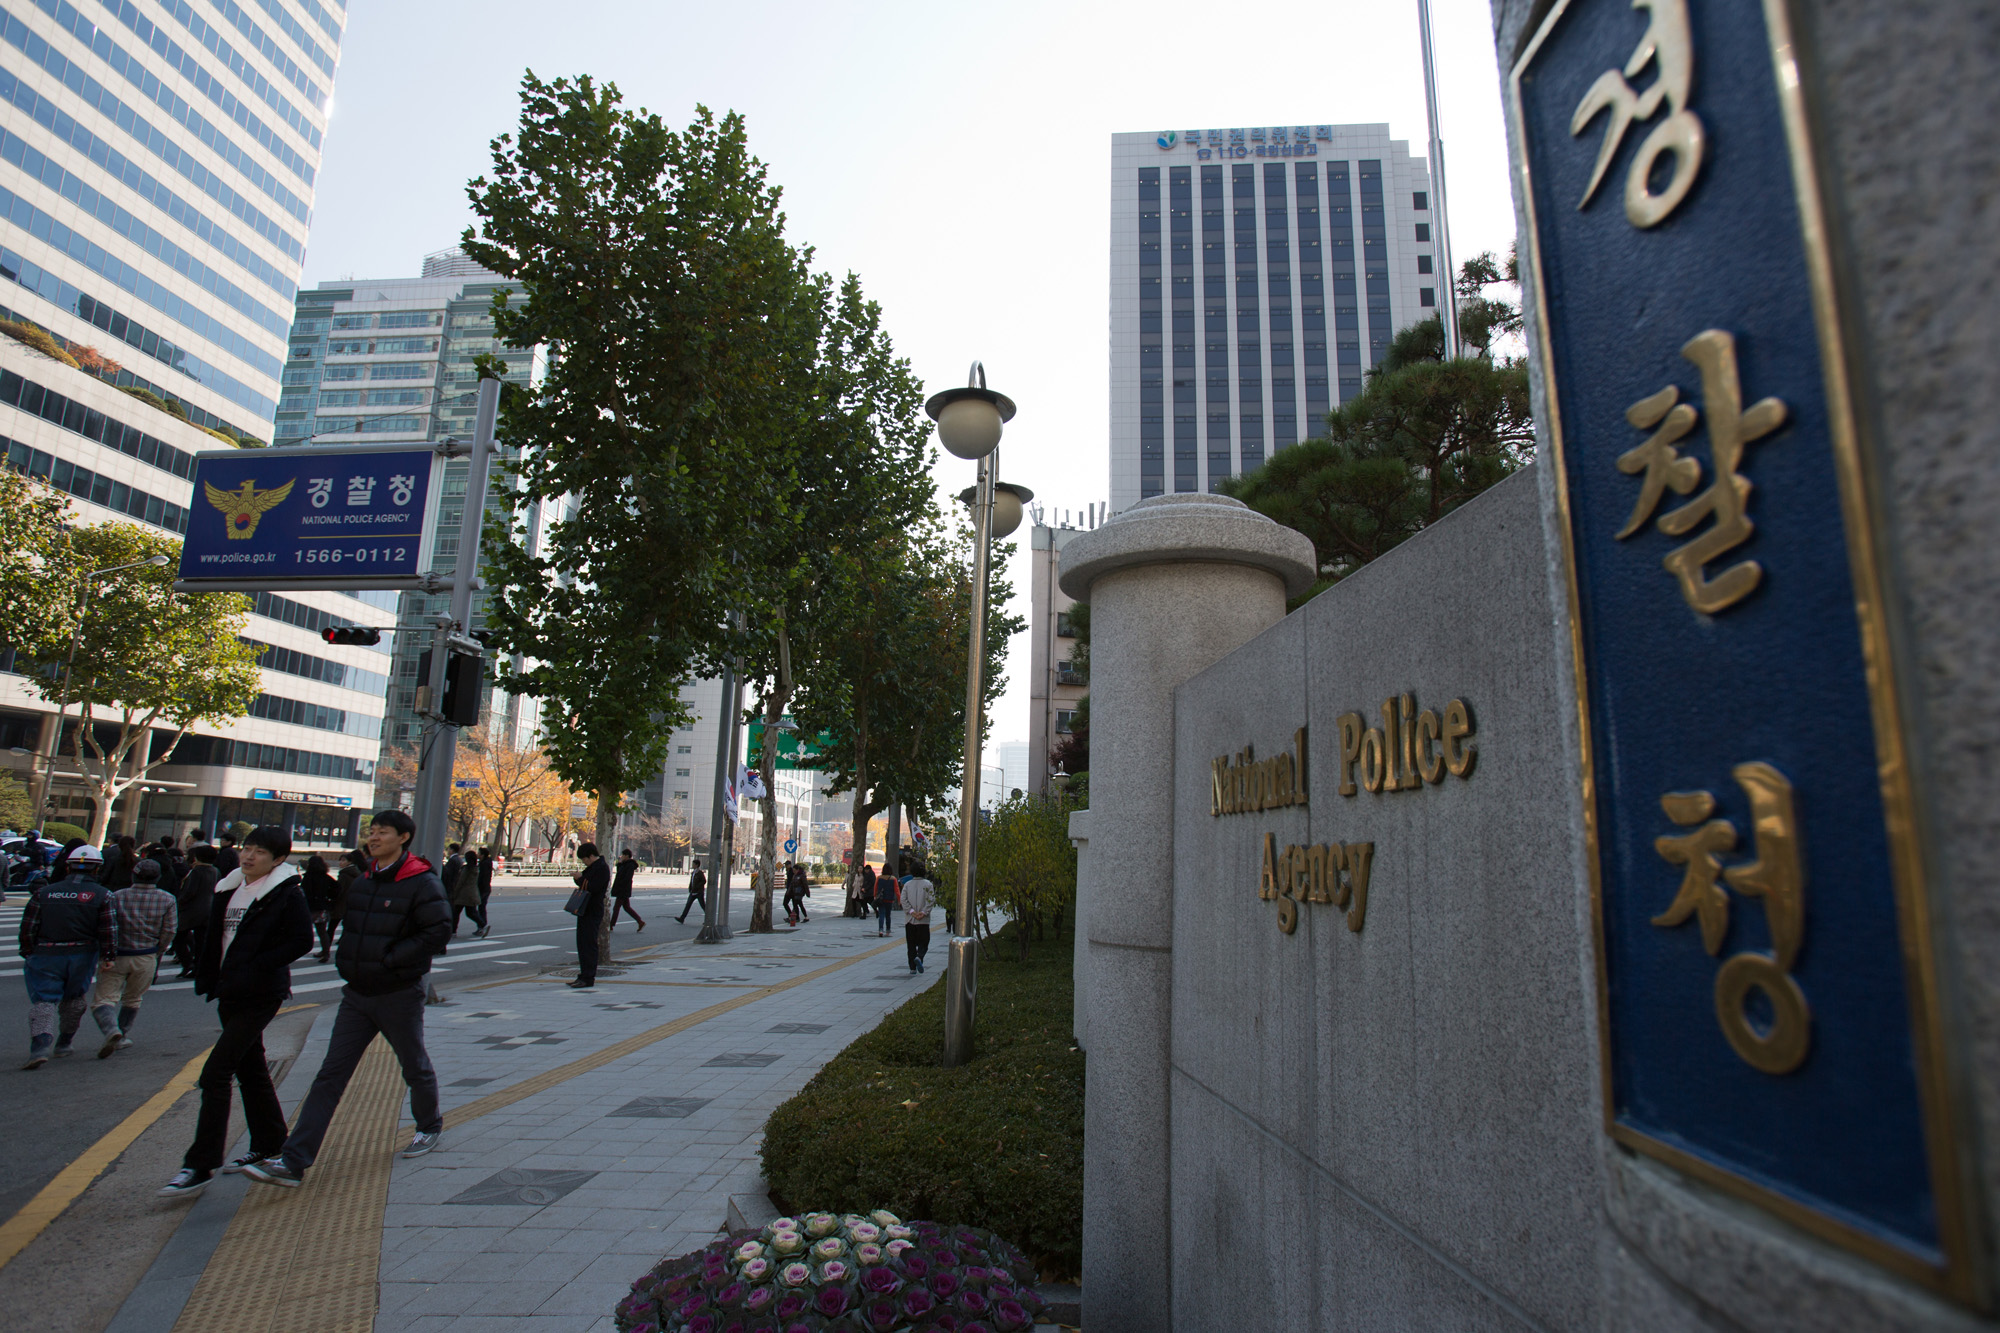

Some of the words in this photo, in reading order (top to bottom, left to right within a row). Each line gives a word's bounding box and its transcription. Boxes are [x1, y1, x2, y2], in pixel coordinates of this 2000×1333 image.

[1185, 125, 1332, 146] 국민권익위원회
[302, 515, 342, 525] NATIONAL
[344, 514, 373, 524] POLICE
[375, 513, 410, 523] AGENCY
[200, 552, 276, 564] www.police.go.kr
[295, 547, 406, 563] 1566-0112
[1211, 727, 1309, 816] National
[1336, 692, 1475, 796] Police
[1259, 832, 1374, 934] Agency
